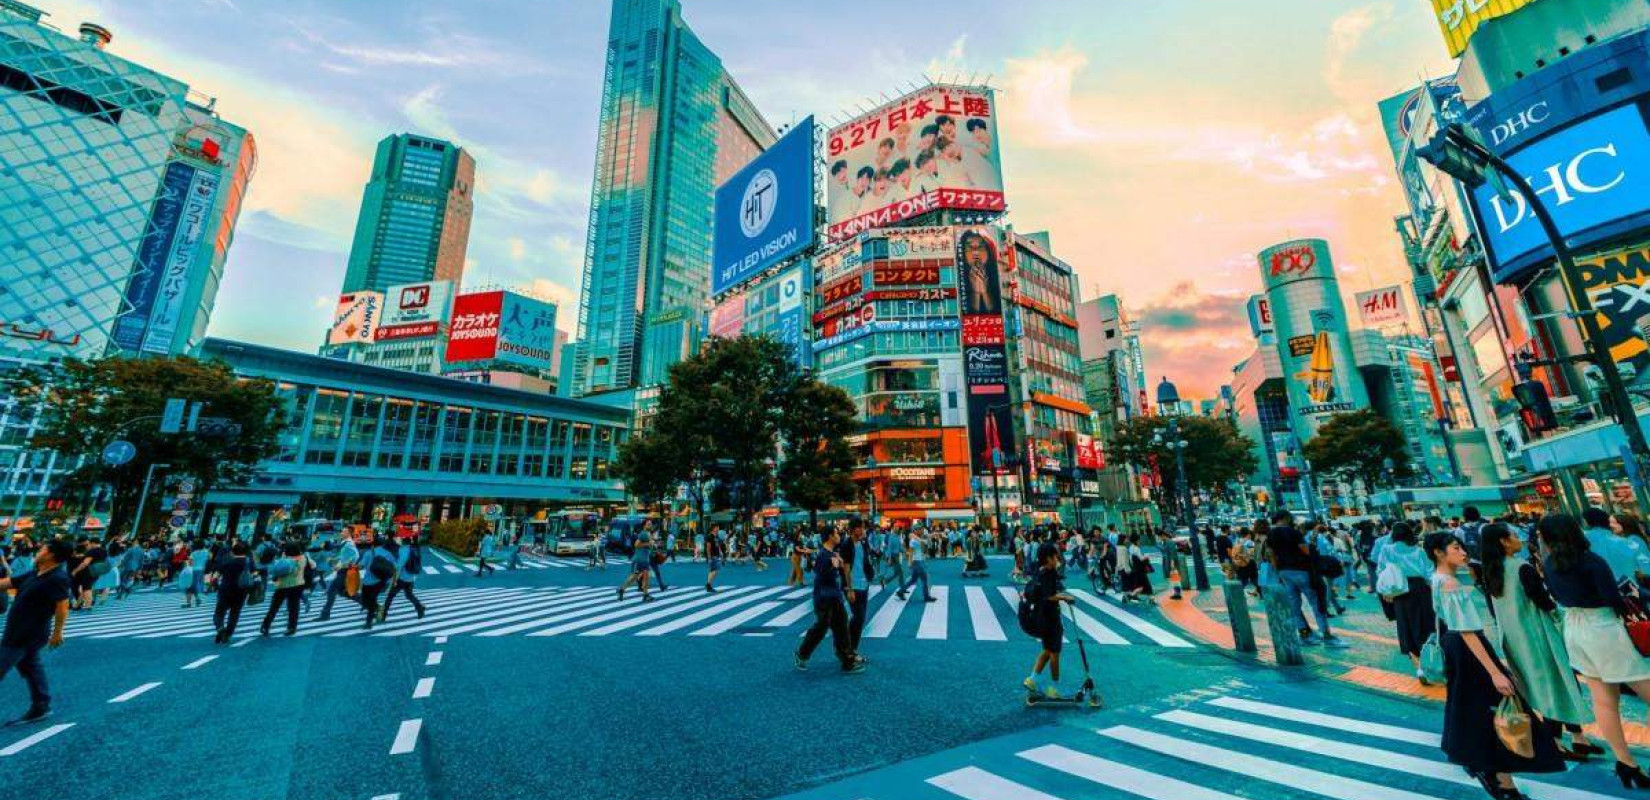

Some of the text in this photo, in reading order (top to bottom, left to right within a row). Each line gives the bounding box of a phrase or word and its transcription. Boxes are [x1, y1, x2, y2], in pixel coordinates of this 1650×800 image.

[829, 118, 881, 157] 9.27
[887, 95, 990, 132] 日本上陸
[1490, 101, 1550, 146] DHC
[942, 191, 1002, 206] ワナワン
[1488, 142, 1626, 234] DHC
[721, 260, 739, 284] HIT
[738, 249, 760, 274] LED
[759, 227, 798, 260] VISION
[1270, 252, 1316, 277] 109
[874, 269, 938, 282] コンタクト
[919, 287, 951, 300] ガスト
[1363, 291, 1397, 314] H&M
[453, 312, 500, 330] カラオケ
[450, 327, 498, 341] JOYSOUND
[497, 341, 551, 361] JOYSOUND
